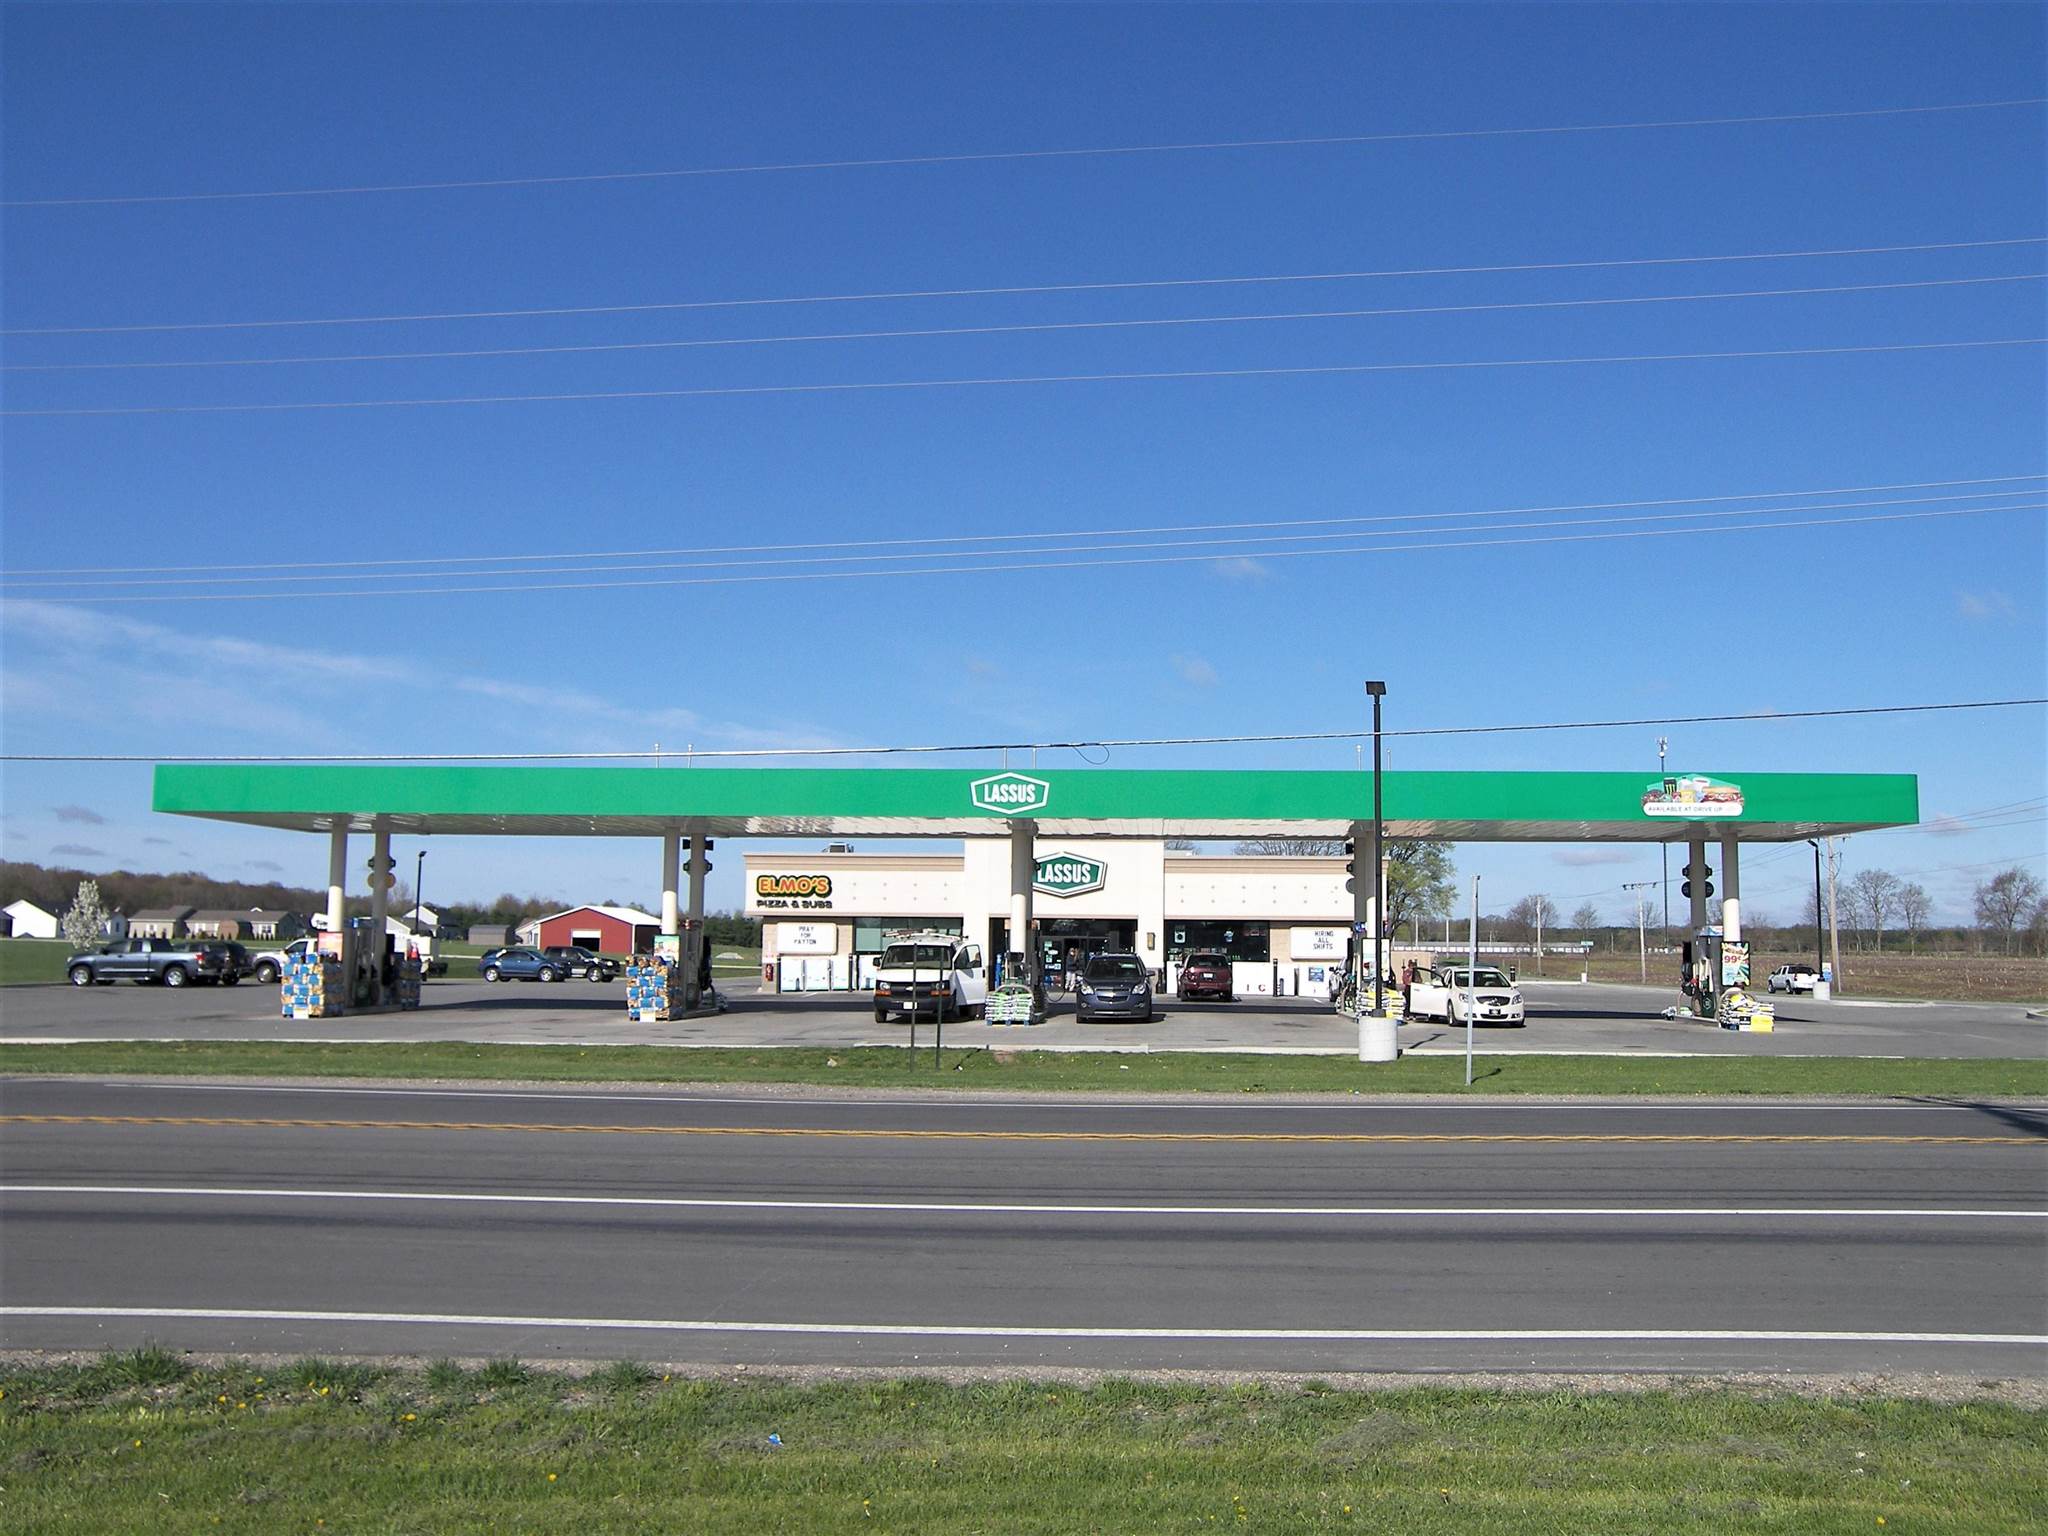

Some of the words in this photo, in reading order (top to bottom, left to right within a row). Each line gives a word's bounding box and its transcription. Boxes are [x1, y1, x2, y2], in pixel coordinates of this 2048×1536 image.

[983, 783, 1036, 803] LASSUS
[1037, 863, 1091, 883] LASSUS
[758, 876, 831, 896] ELMO'S
[757, 899, 789, 908] PIZZA
[791, 900, 800, 909] &
[802, 900, 833, 909] SUBS
